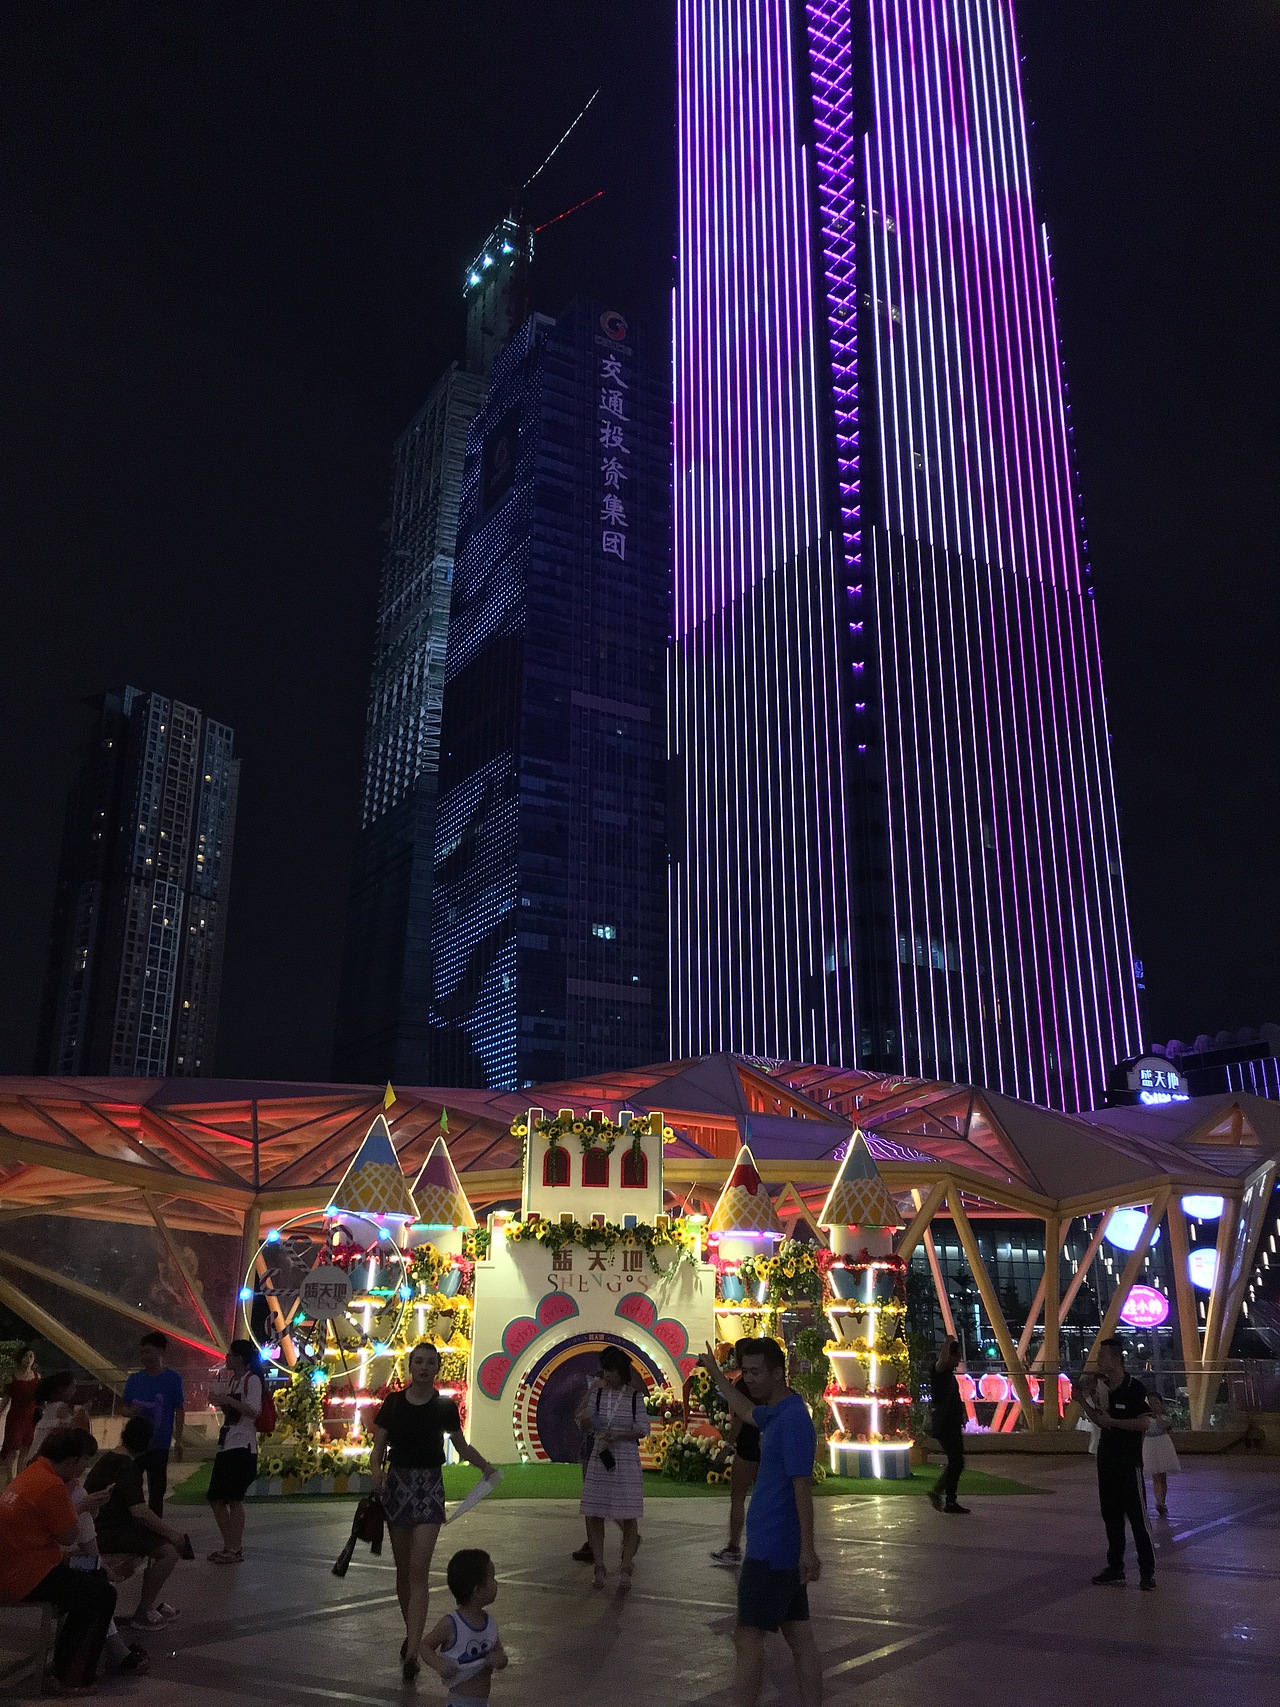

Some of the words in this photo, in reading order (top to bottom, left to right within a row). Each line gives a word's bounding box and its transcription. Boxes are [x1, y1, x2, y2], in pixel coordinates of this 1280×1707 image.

[599, 353, 630, 561] 交通投资集团
[1140, 1069, 1179, 1090] 盛天地
